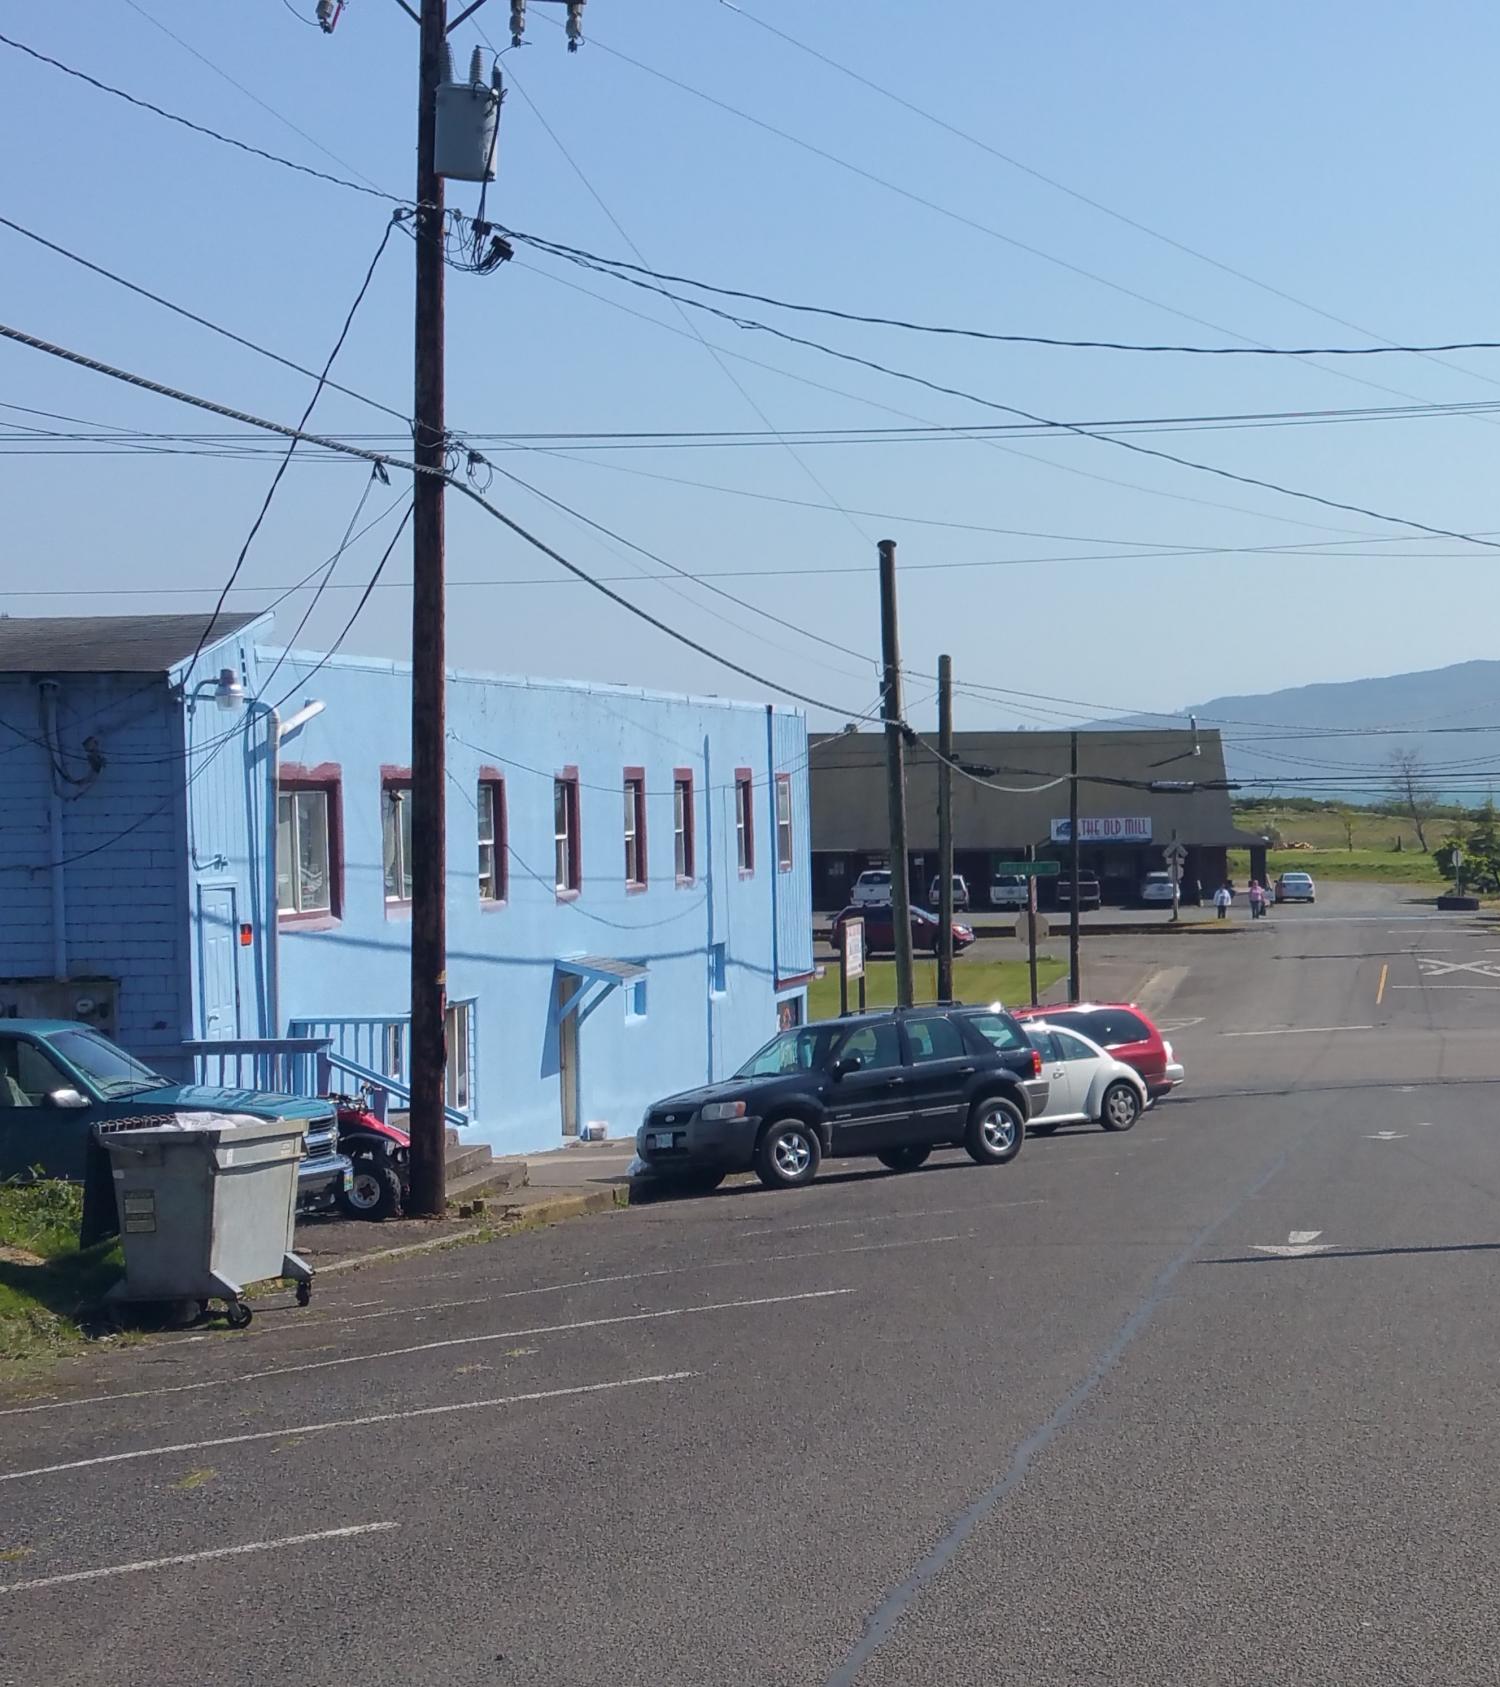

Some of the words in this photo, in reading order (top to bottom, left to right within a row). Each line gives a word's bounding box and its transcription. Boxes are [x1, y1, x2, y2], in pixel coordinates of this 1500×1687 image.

[1081, 820, 1099, 836] THE
[1104, 819, 1121, 836] OLD
[1125, 819, 1147, 834] MILL
